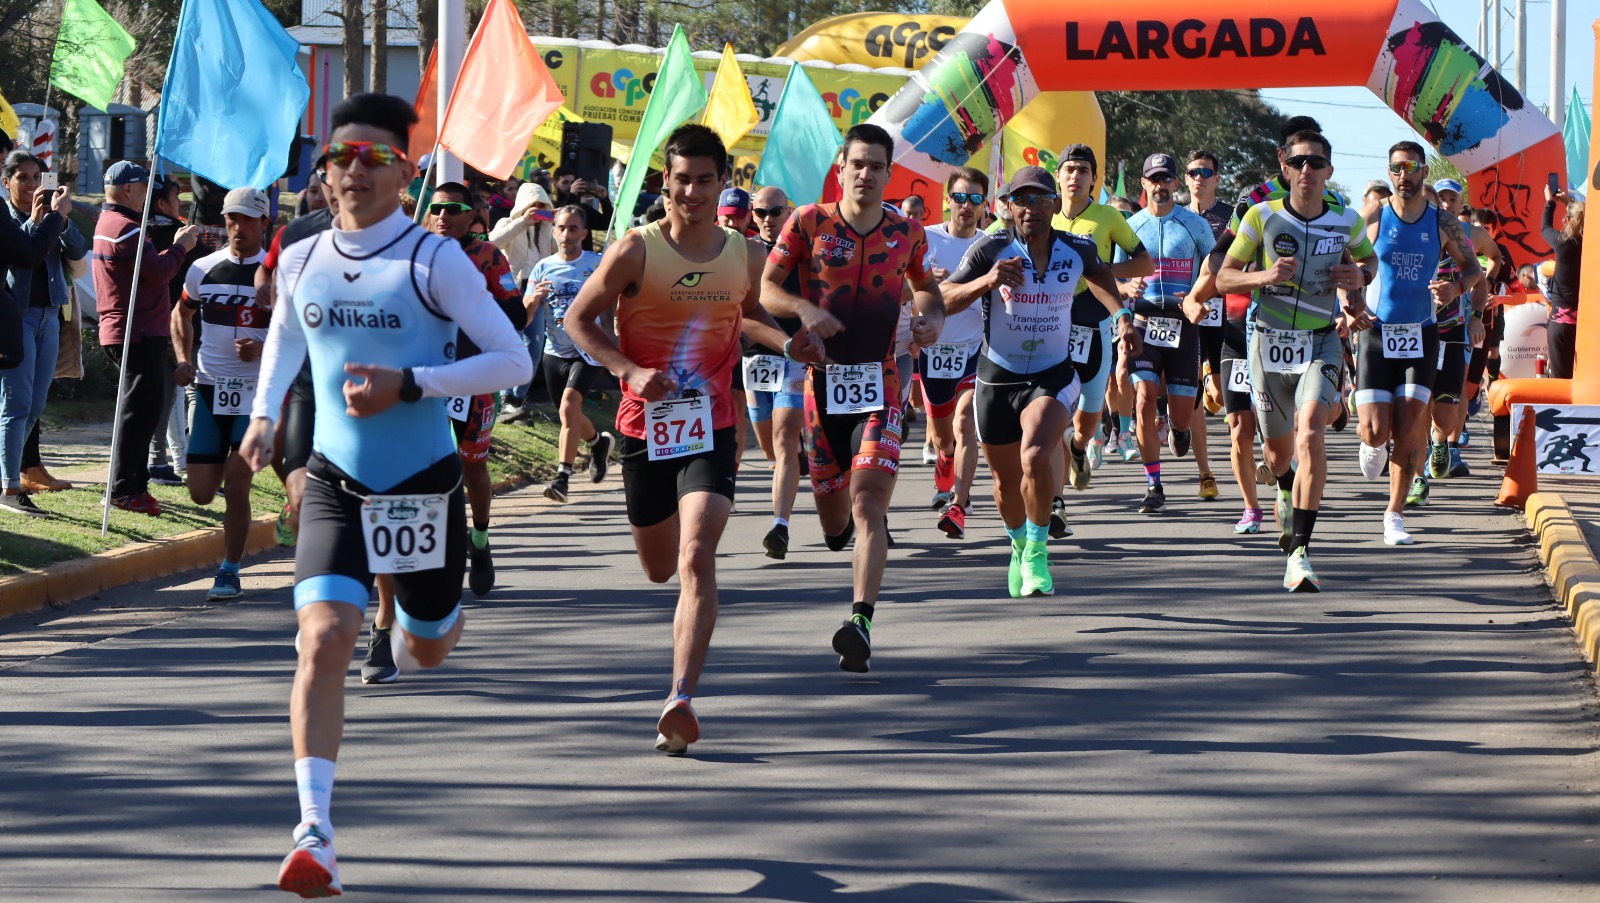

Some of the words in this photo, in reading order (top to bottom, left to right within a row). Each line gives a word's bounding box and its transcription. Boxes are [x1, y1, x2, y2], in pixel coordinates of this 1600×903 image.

[1066, 17, 1327, 60] LARGADA
[583, 105, 617, 113] ASOCIACION
[582, 111, 617, 121] PRUEBAS
[619, 114, 642, 123] COMB
[820, 233, 834, 243] DX
[835, 237, 856, 250] TRIA
[1171, 260, 1191, 268] TEAM
[1391, 252, 1424, 268] BENITEZ
[1057, 272, 1070, 283] G
[1396, 267, 1419, 281] ARG
[332, 299, 374, 307] gimnasio
[549, 298, 574, 308] Jee
[328, 308, 402, 329] Nikaia
[1013, 314, 1060, 323] Transporte
[1149, 329, 1177, 342] 005
[1387, 337, 1419, 352] 022
[1269, 345, 1304, 363] 001
[933, 356, 963, 371] 045
[751, 369, 778, 384] 121
[219, 391, 240, 407] 90
[833, 383, 877, 404] 035
[653, 417, 705, 445] 874
[656, 443, 705, 455] BIOGRAFICA
[856, 456, 873, 465] DX
[373, 523, 436, 557] 003
